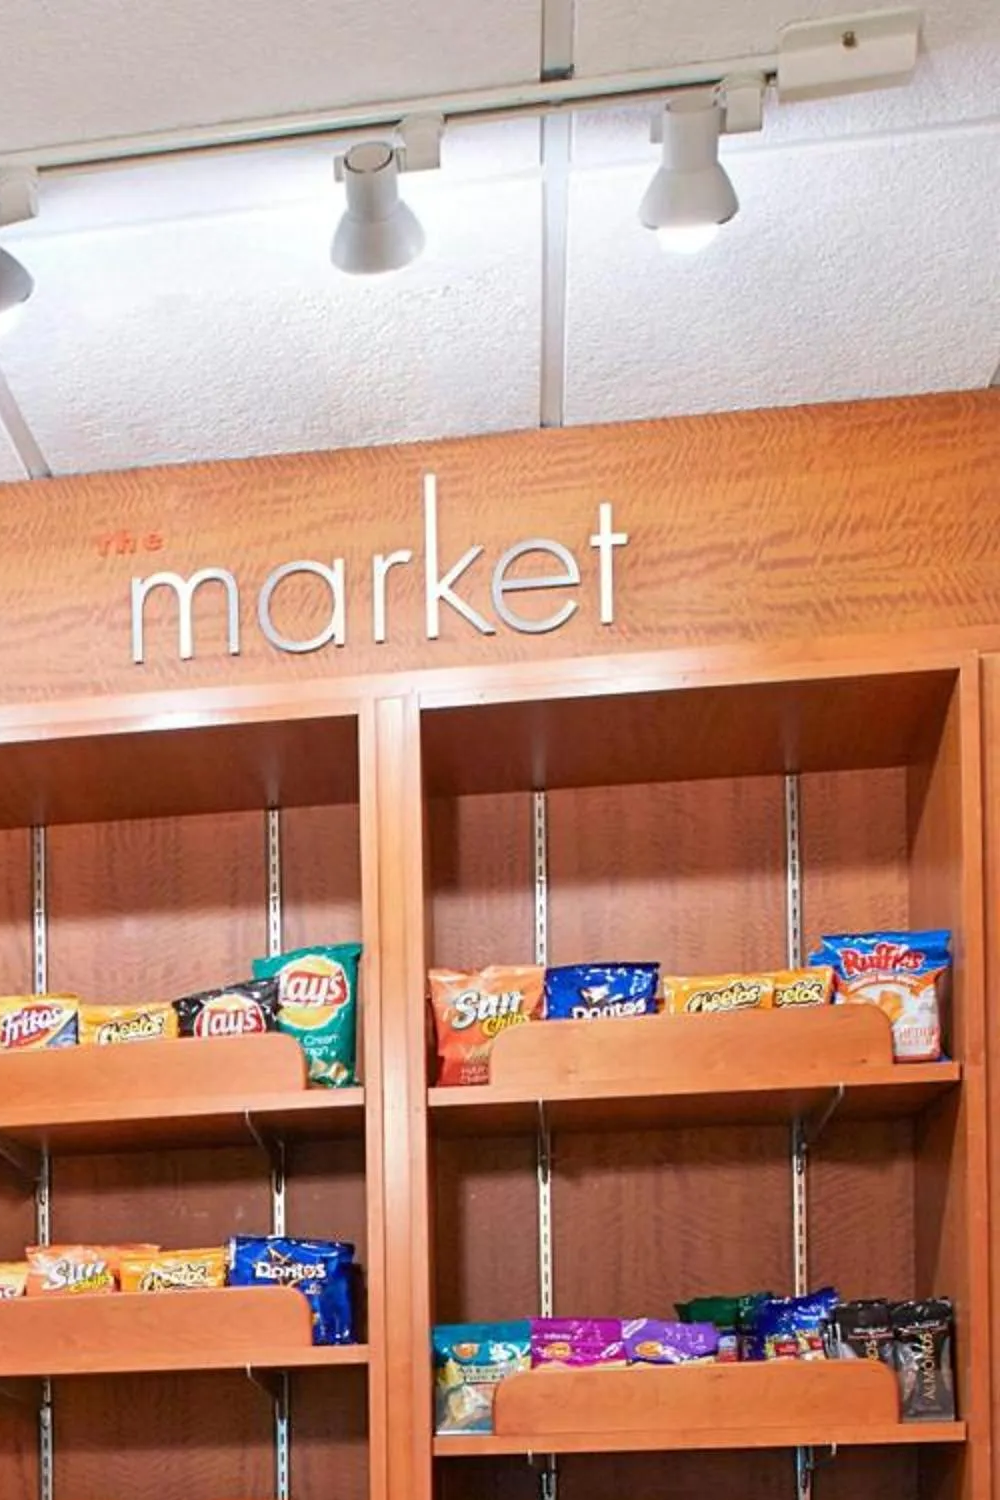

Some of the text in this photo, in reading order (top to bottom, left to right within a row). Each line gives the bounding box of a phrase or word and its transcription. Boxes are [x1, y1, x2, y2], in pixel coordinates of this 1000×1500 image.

[129, 473, 629, 664] market
[839, 942, 924, 975] Ruffles
[0, 1005, 64, 1047] Fritos
[255, 1261, 327, 1280] Doritos
